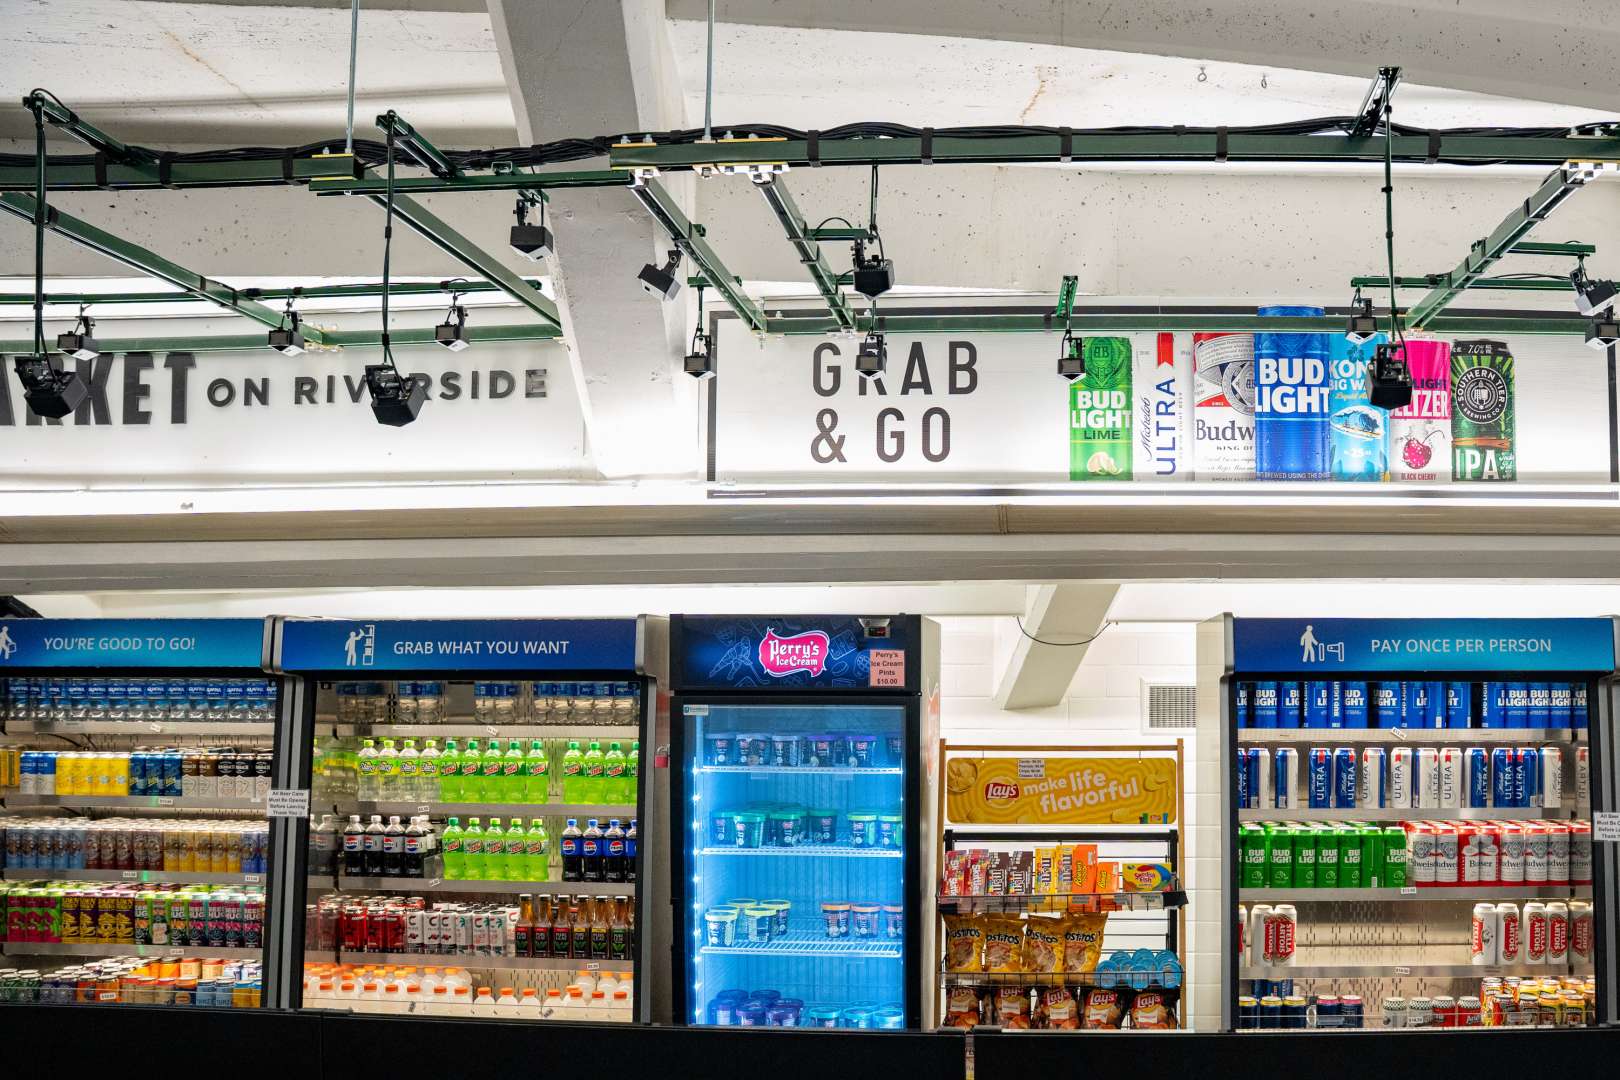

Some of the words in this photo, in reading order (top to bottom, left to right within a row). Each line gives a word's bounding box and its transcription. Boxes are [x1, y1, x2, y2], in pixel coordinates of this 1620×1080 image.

[1259, 358, 1325, 385] BUD
[1457, 369, 1496, 402] SOUTHERN
[1495, 380, 1505, 403] TIER
[207, 377, 270, 407] ON
[295, 368, 548, 404] RIVRSIDE
[1078, 391, 1126, 409] BUD
[1255, 386, 1329, 413] LIGHT
[1072, 410, 1131, 428] LIGHT
[1155, 377, 1176, 475] ULTRA
[1463, 407, 1492, 420] BREWING
[810, 408, 847, 463] &
[876, 407, 950, 463] GO
[1084, 430, 1120, 440] LIME
[1139, 397, 1153, 461] Michelob
[1456, 449, 1499, 480] IPA
[44, 637, 95, 650] YOU'RE
[99, 637, 142, 650] GOOD
[147, 637, 166, 650] TO
[169, 637, 195, 650] GO!
[393, 641, 434, 655] GRAB
[437, 641, 483, 655] WHAT
[486, 641, 518, 655] YOU
[522, 641, 570, 655] WANT
[768, 639, 820, 661] Perry's
[875, 651, 899, 659] Perry's
[1371, 639, 1401, 653] PAY
[1405, 639, 1452, 653] ONCE
[1455, 639, 1484, 653] PER
[1489, 639, 1551, 653] PERSON
[1024, 777, 1068, 795] make
[1069, 769, 1107, 792] life
[1040, 777, 1139, 814] flavorful
[1316, 766, 1325, 799] ULTRA
[1346, 766, 1355, 799] ULTRA
[1394, 766, 1402, 799] ULTRA
[1505, 766, 1513, 799] ULTRA
[1515, 766, 1523, 799] ULTRA
